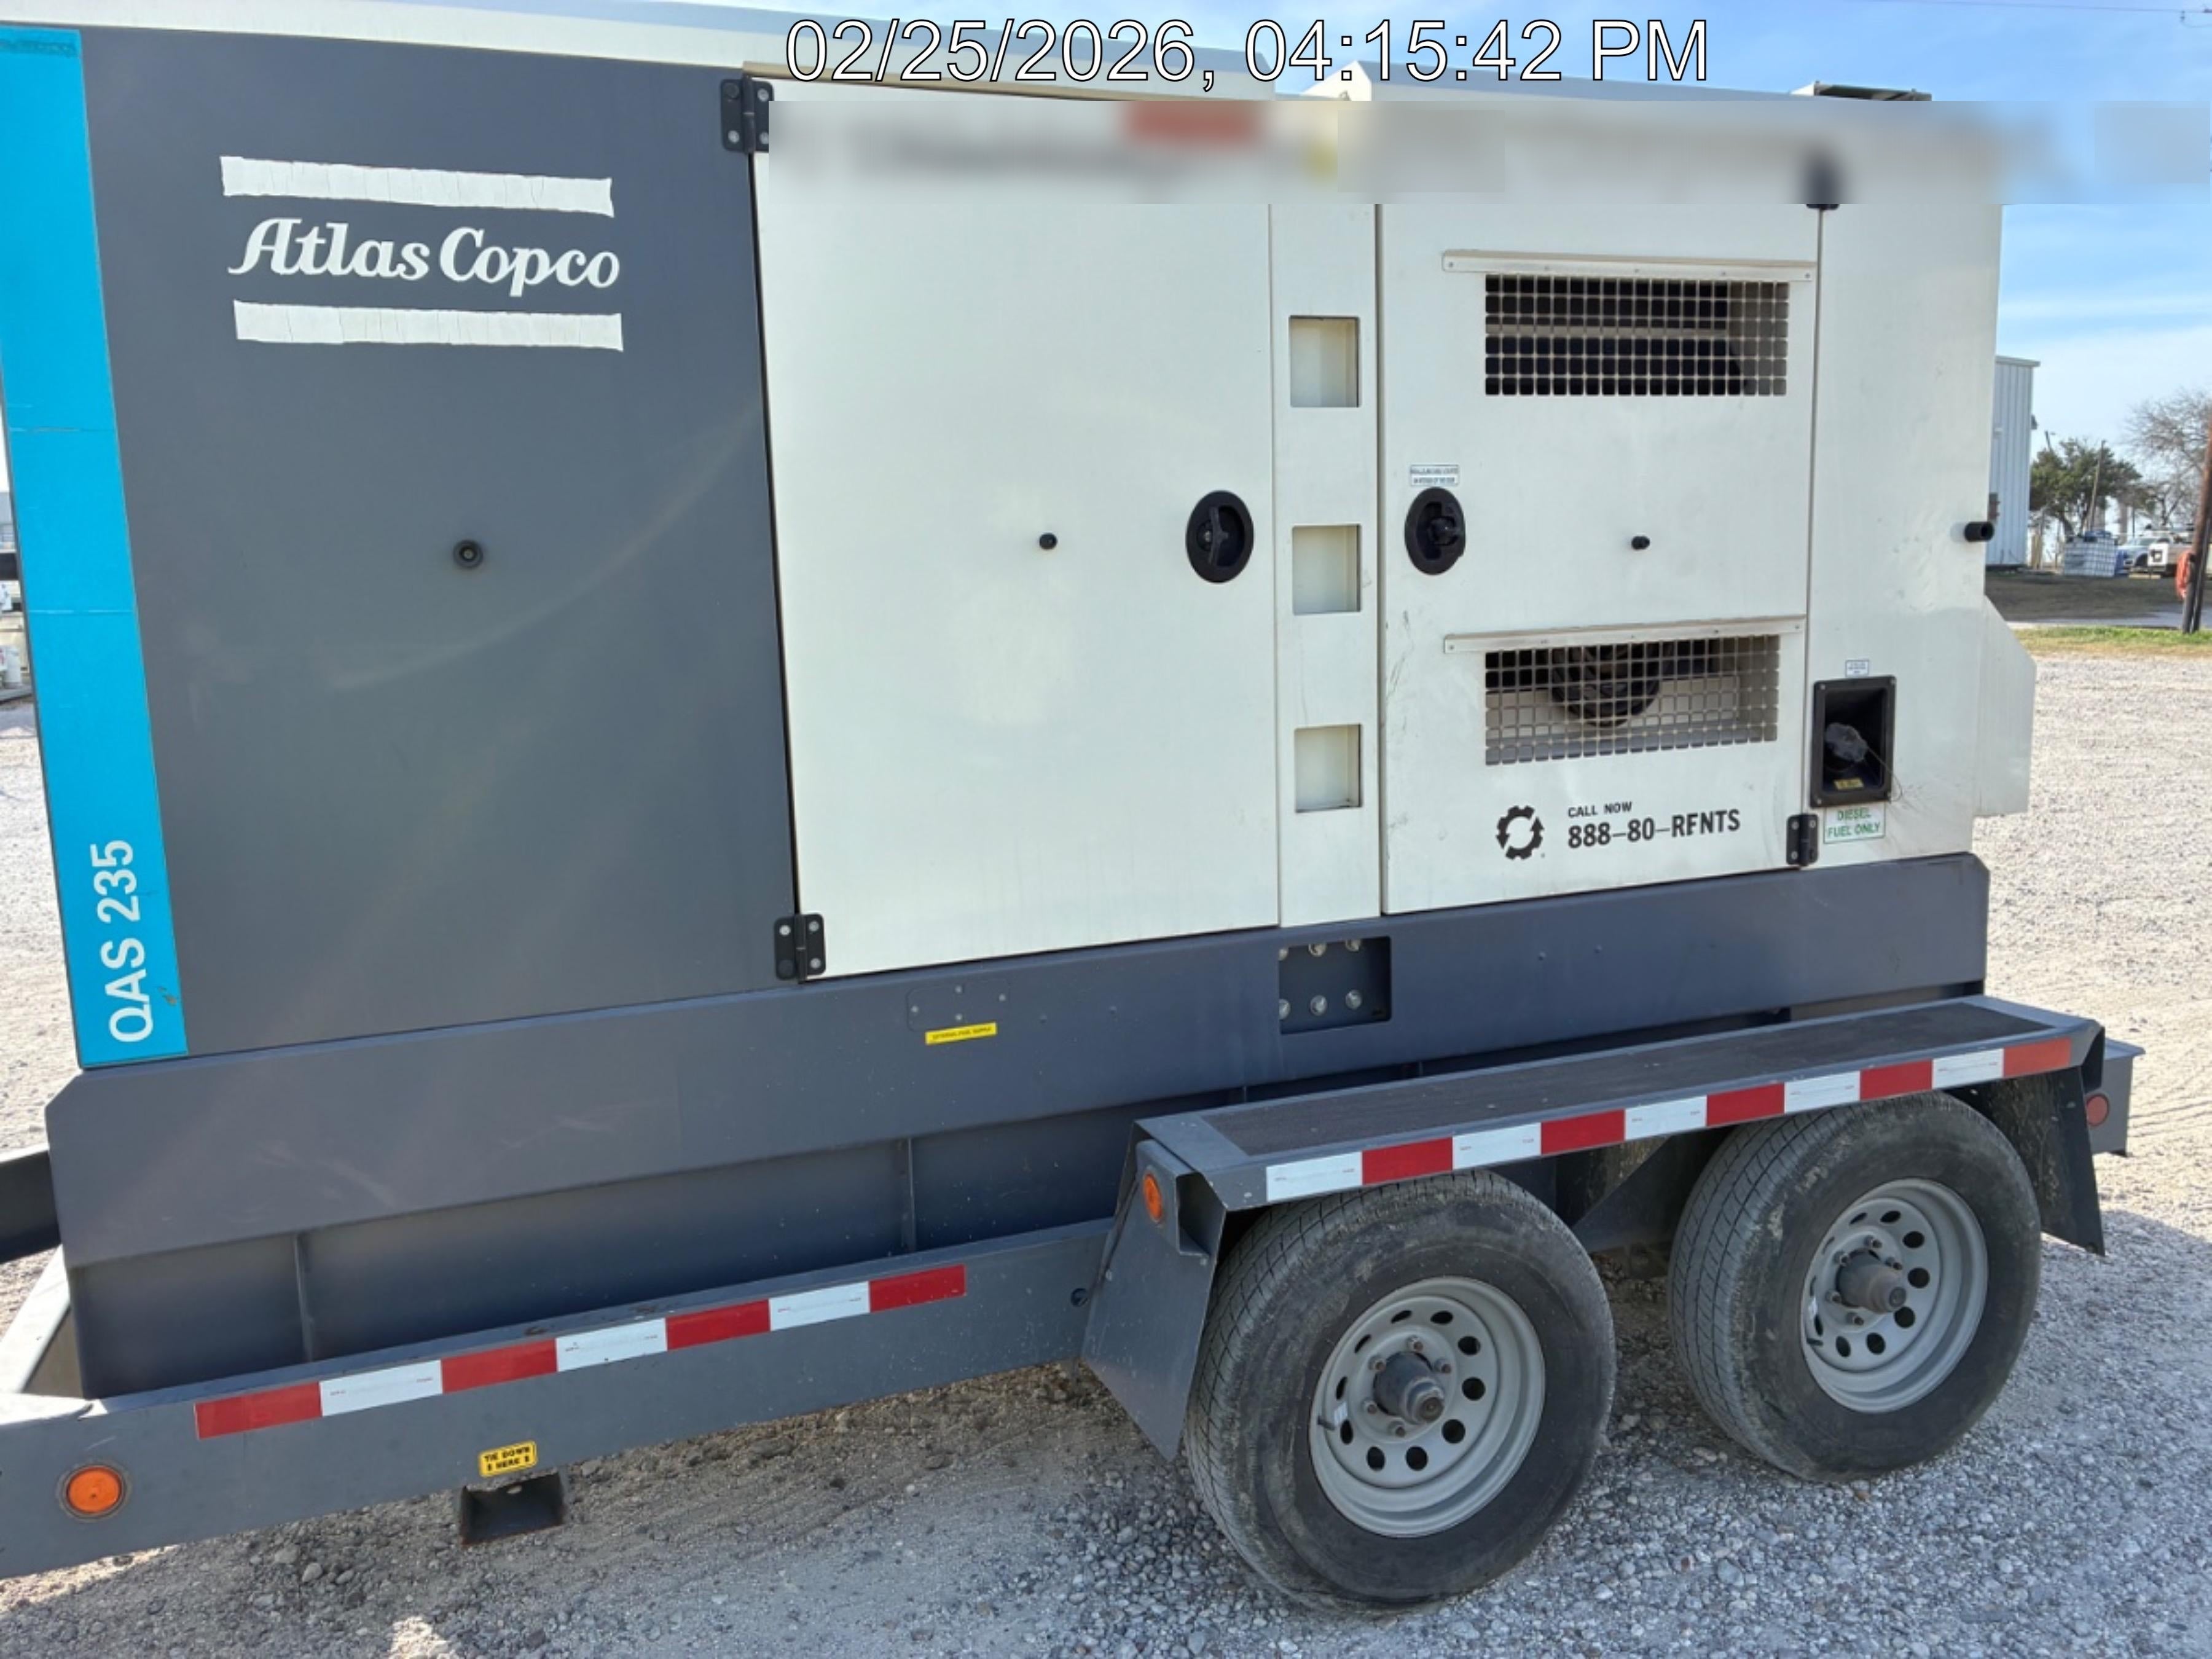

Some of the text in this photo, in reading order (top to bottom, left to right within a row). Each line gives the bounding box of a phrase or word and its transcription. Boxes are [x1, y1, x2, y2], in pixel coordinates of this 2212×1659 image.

[227, 218, 620, 297] Atlas Copco
[1567, 801, 1633, 818] CALL NOW
[1838, 807, 1872, 821] DIESEL
[1828, 822, 1880, 837] FUEL ONLY
[90, 840, 154, 1042] QAS 235
[502, 1446, 530, 1458] DOWN
[496, 1458, 520, 1469] HERE
